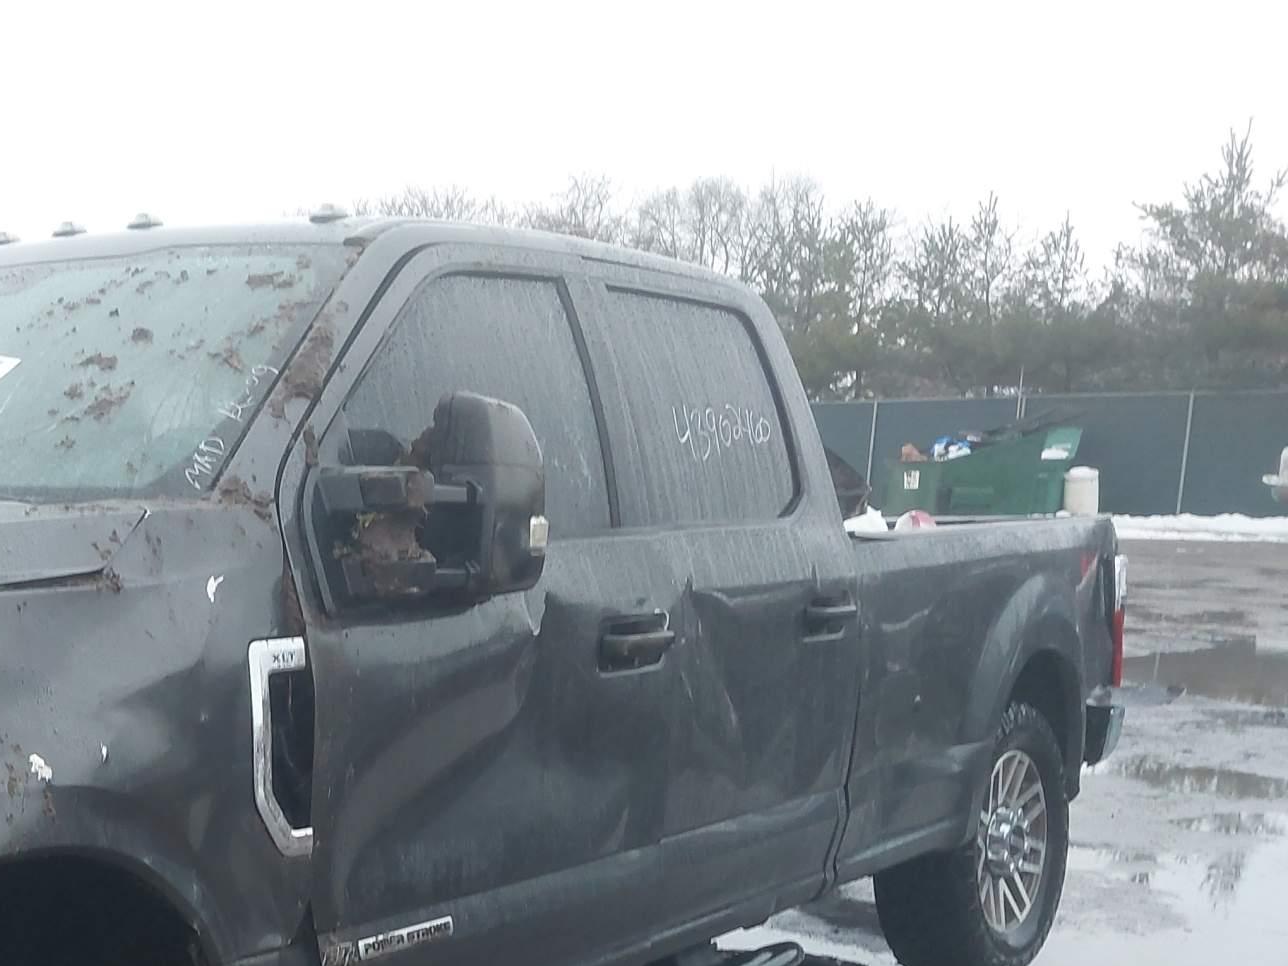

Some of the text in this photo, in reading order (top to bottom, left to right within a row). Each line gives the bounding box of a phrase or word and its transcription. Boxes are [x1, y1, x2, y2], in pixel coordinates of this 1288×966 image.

[671, 403, 771, 462] 43902460
[272, 650, 296, 664] XLT
[363, 933, 405, 955] POWER
[406, 921, 451, 944] STROKE
